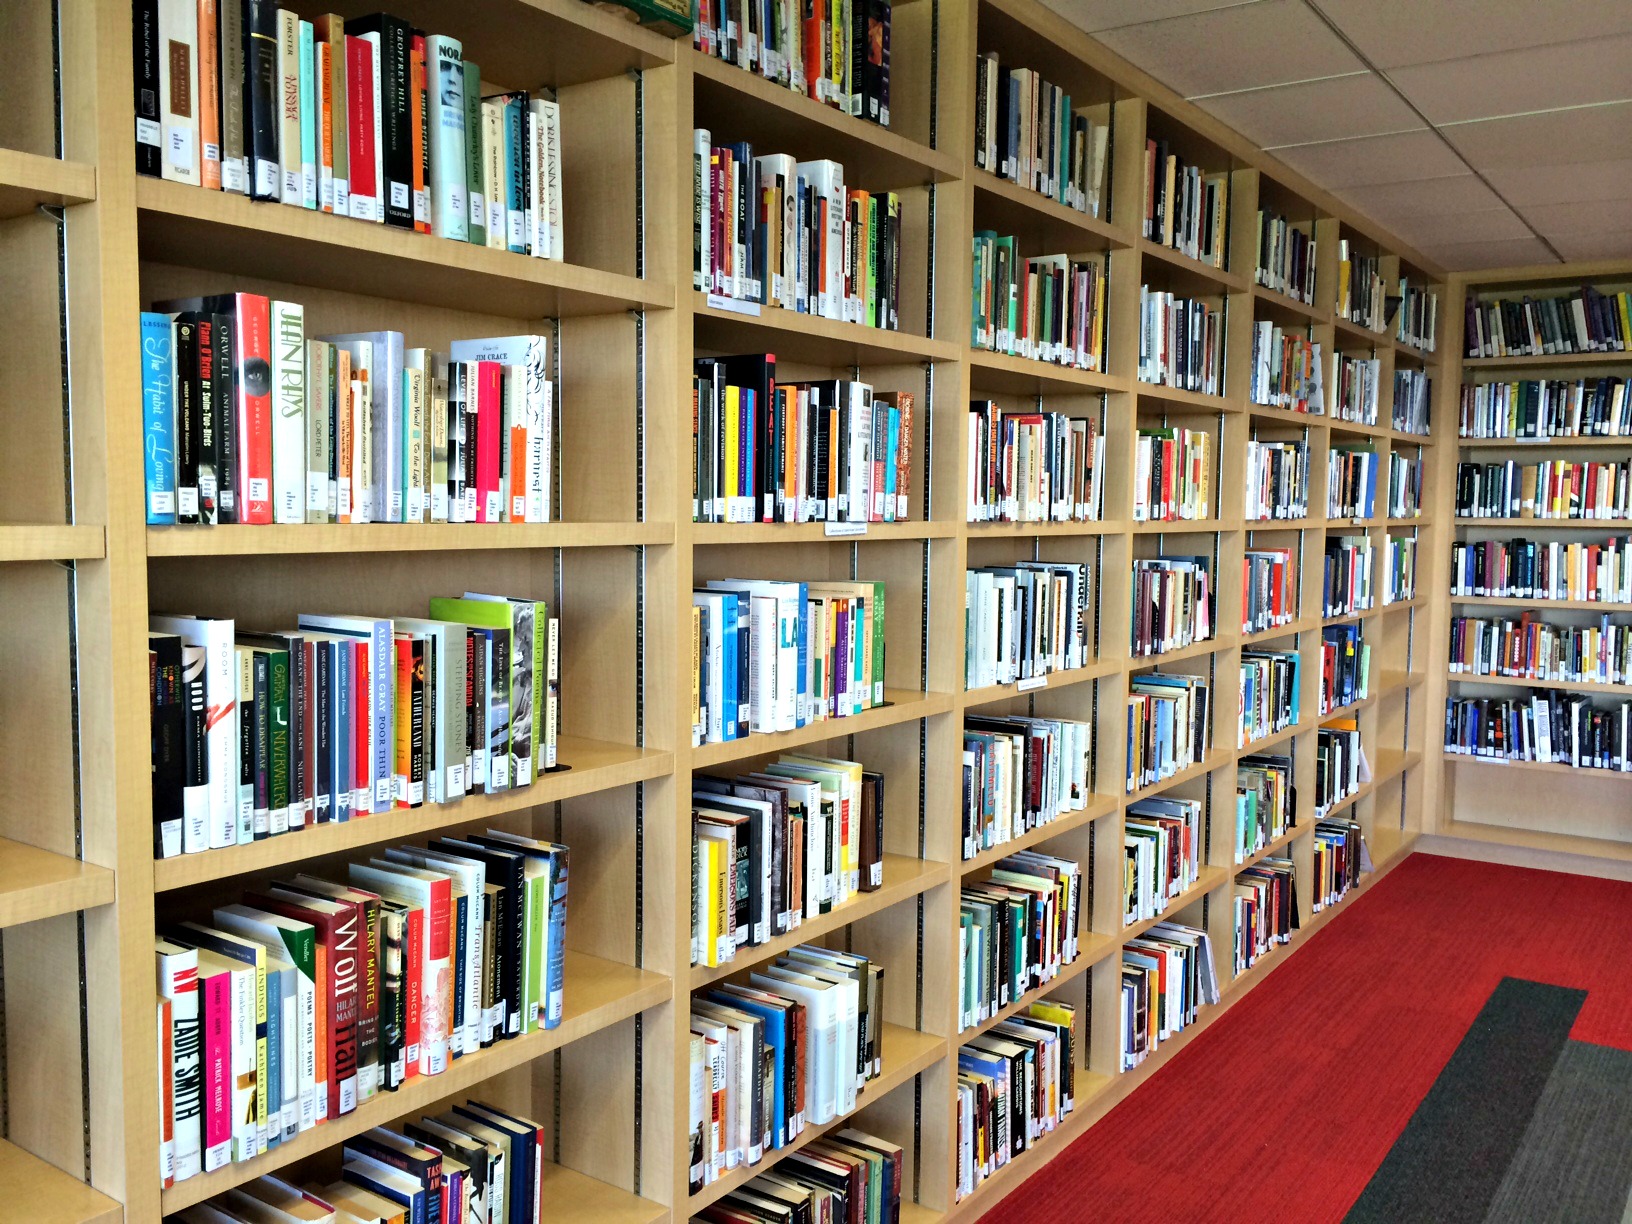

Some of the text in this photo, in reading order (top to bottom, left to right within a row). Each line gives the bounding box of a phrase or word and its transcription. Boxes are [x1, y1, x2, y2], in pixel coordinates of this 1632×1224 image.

[397, 29, 405, 84] GEOFFREY
[389, 210, 411, 218] OXFORD
[220, 326, 230, 380] ORWELL
[280, 309, 303, 419] JEAN RHYS
[144, 337, 173, 491] The Habit of Loving
[721, 422, 725, 430] of
[378, 627, 386, 679] ALASDAIR
[378, 684, 386, 712] GRAY
[454, 659, 462, 709] STEPPING
[258, 714, 265, 725] TO
[173, 967, 198, 994] NW
[366, 909, 375, 1009] HILARY MANTEL
[410, 982, 418, 1024] DANCER
[238, 1015, 246, 1046] Question
[175, 1068, 200, 1122] SMITH
[428, 1193, 440, 1220] FIVE
